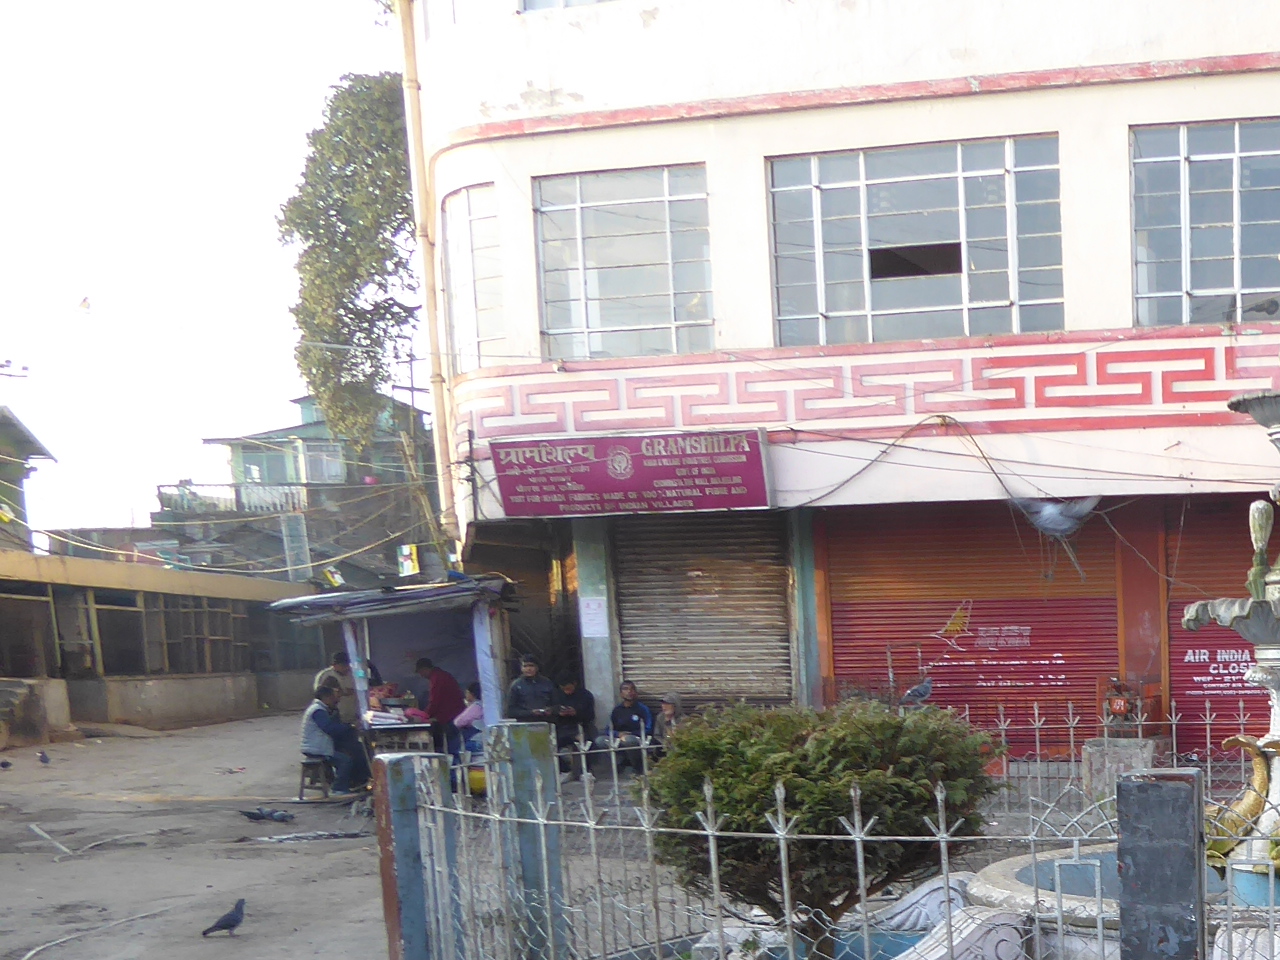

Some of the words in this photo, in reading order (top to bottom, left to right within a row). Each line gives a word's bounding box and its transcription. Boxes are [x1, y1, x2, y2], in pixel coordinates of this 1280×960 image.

[641, 434, 750, 456] GRAMSHILPA
[666, 488, 702, 497] NATURAL
[1184, 649, 1209, 662] AIR
[1216, 649, 1251, 662] INDIA
